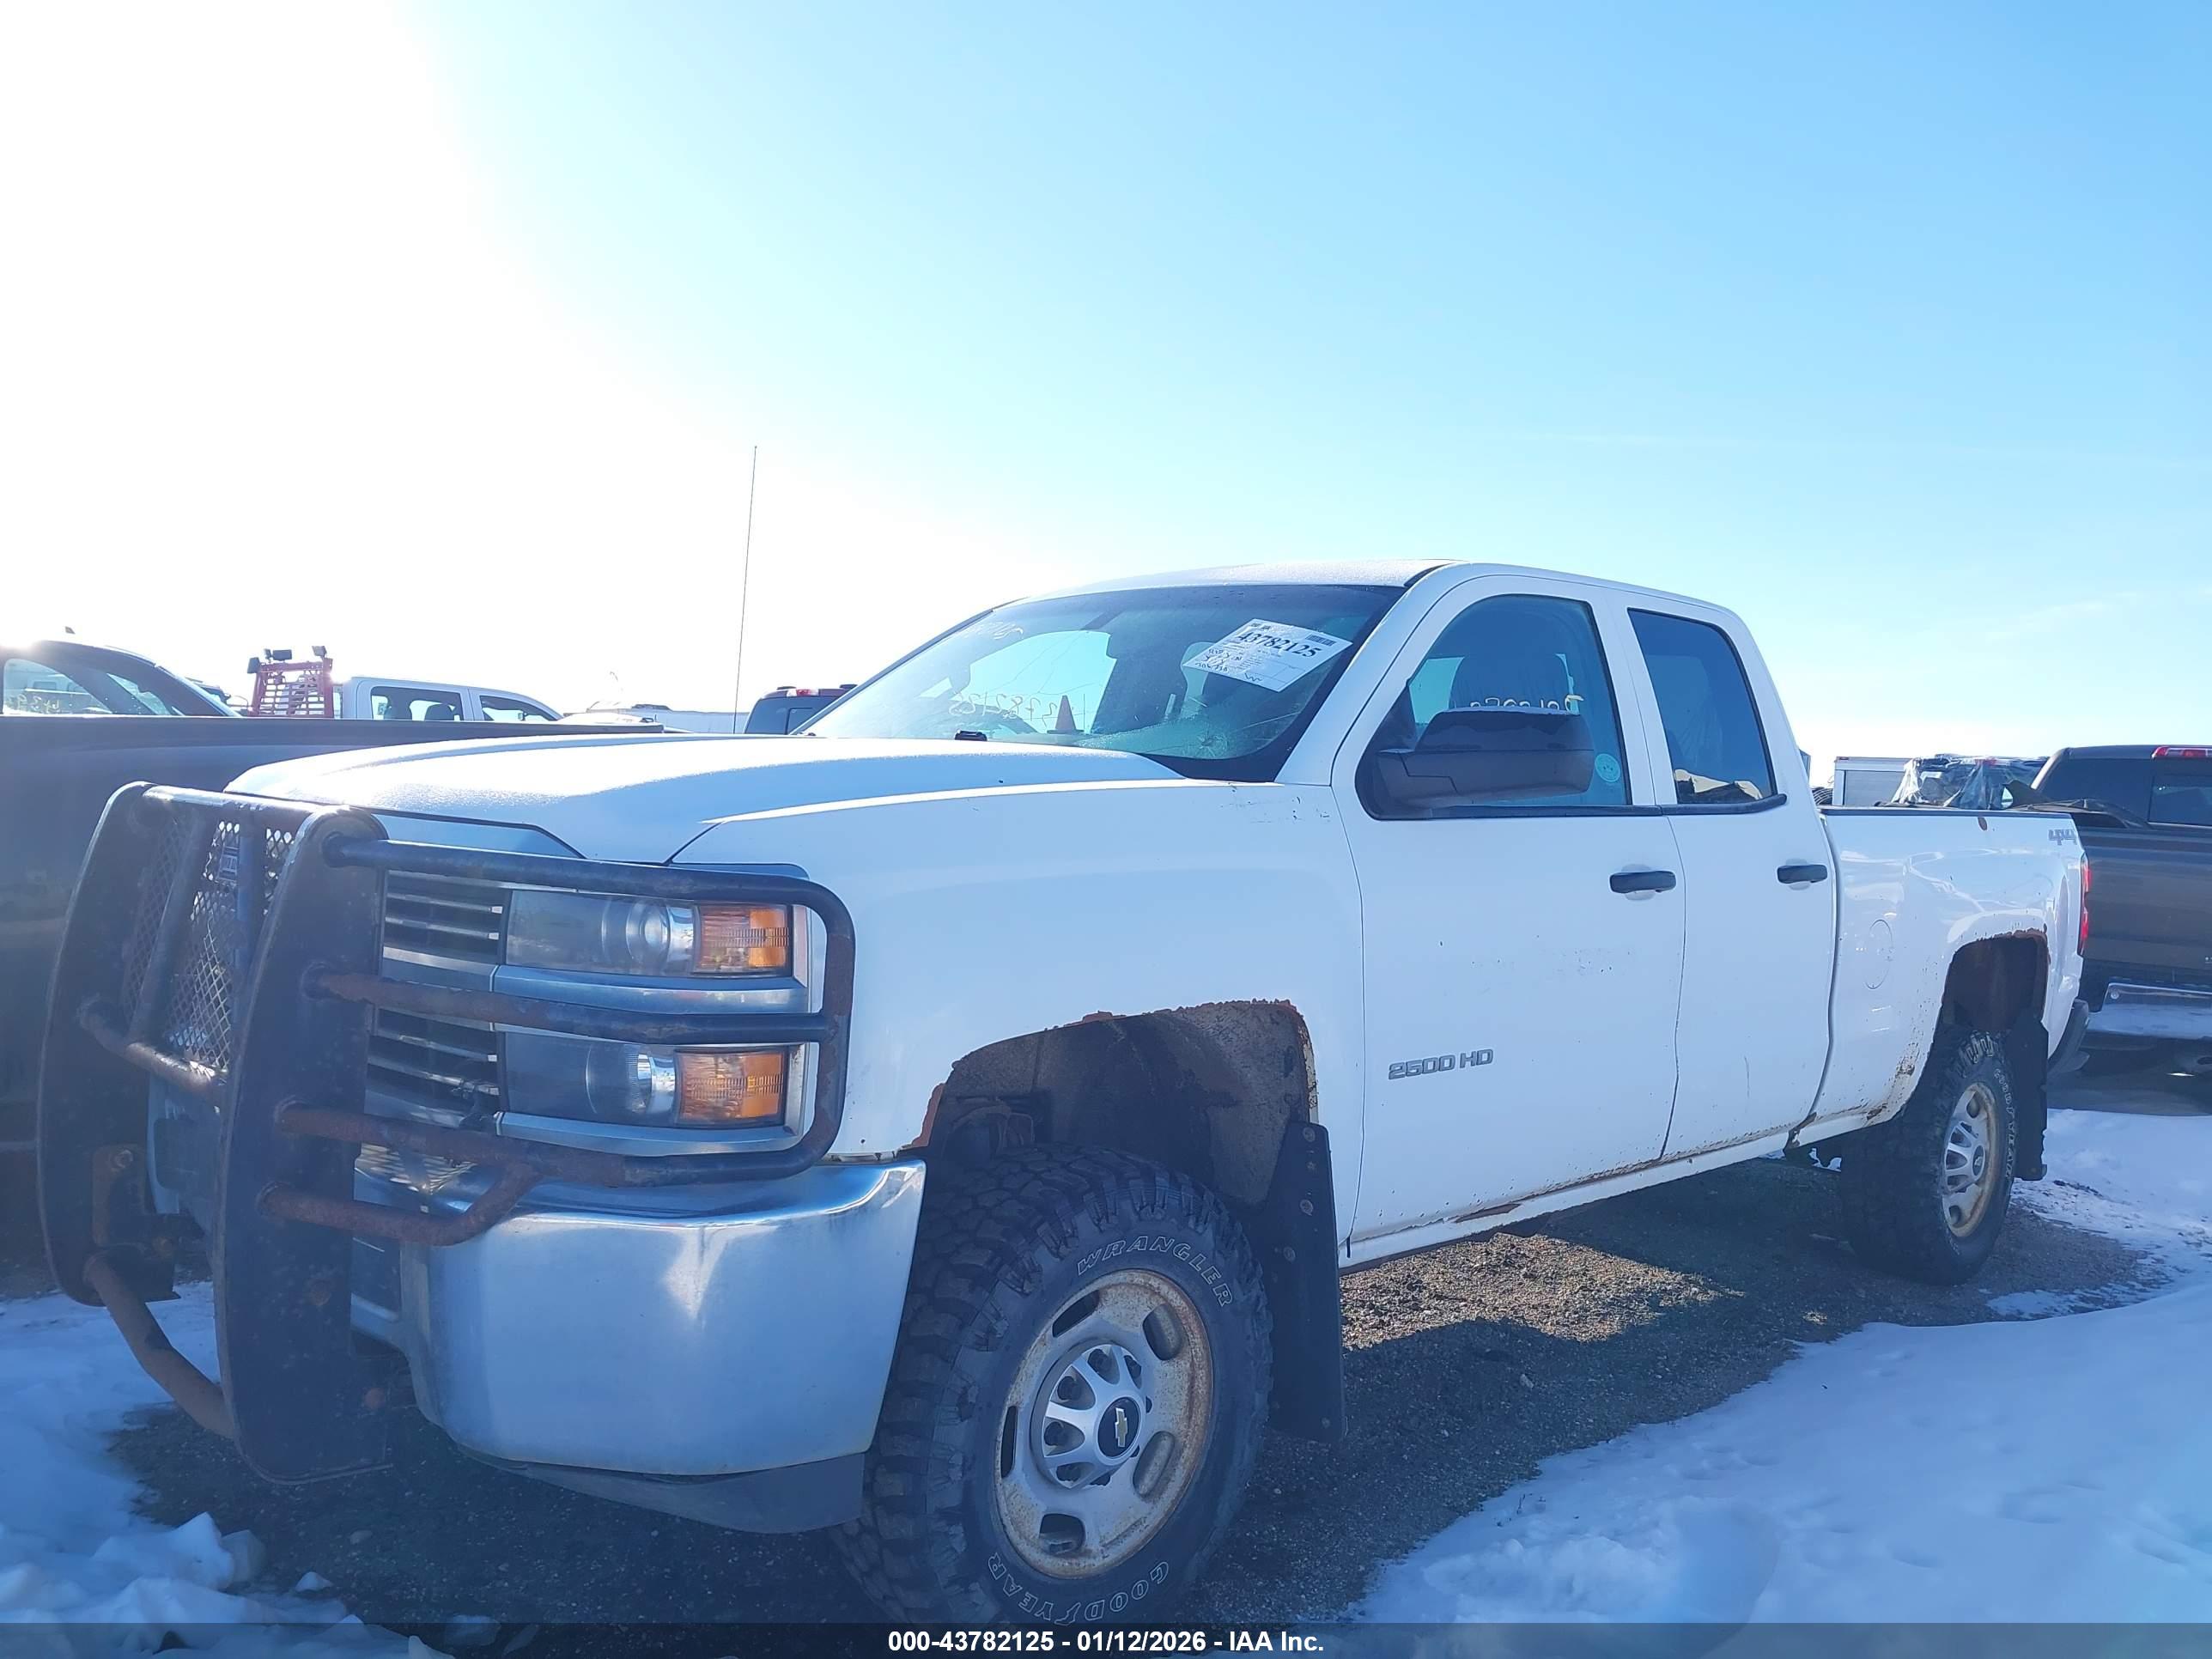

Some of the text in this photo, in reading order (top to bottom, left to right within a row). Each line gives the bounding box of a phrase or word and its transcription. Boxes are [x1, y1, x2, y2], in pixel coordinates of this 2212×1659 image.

[1236, 630, 1322, 658] 43782125
[1388, 1048, 1494, 1080] 2500 HD
[1077, 1236, 1234, 1307] WRANGLER
